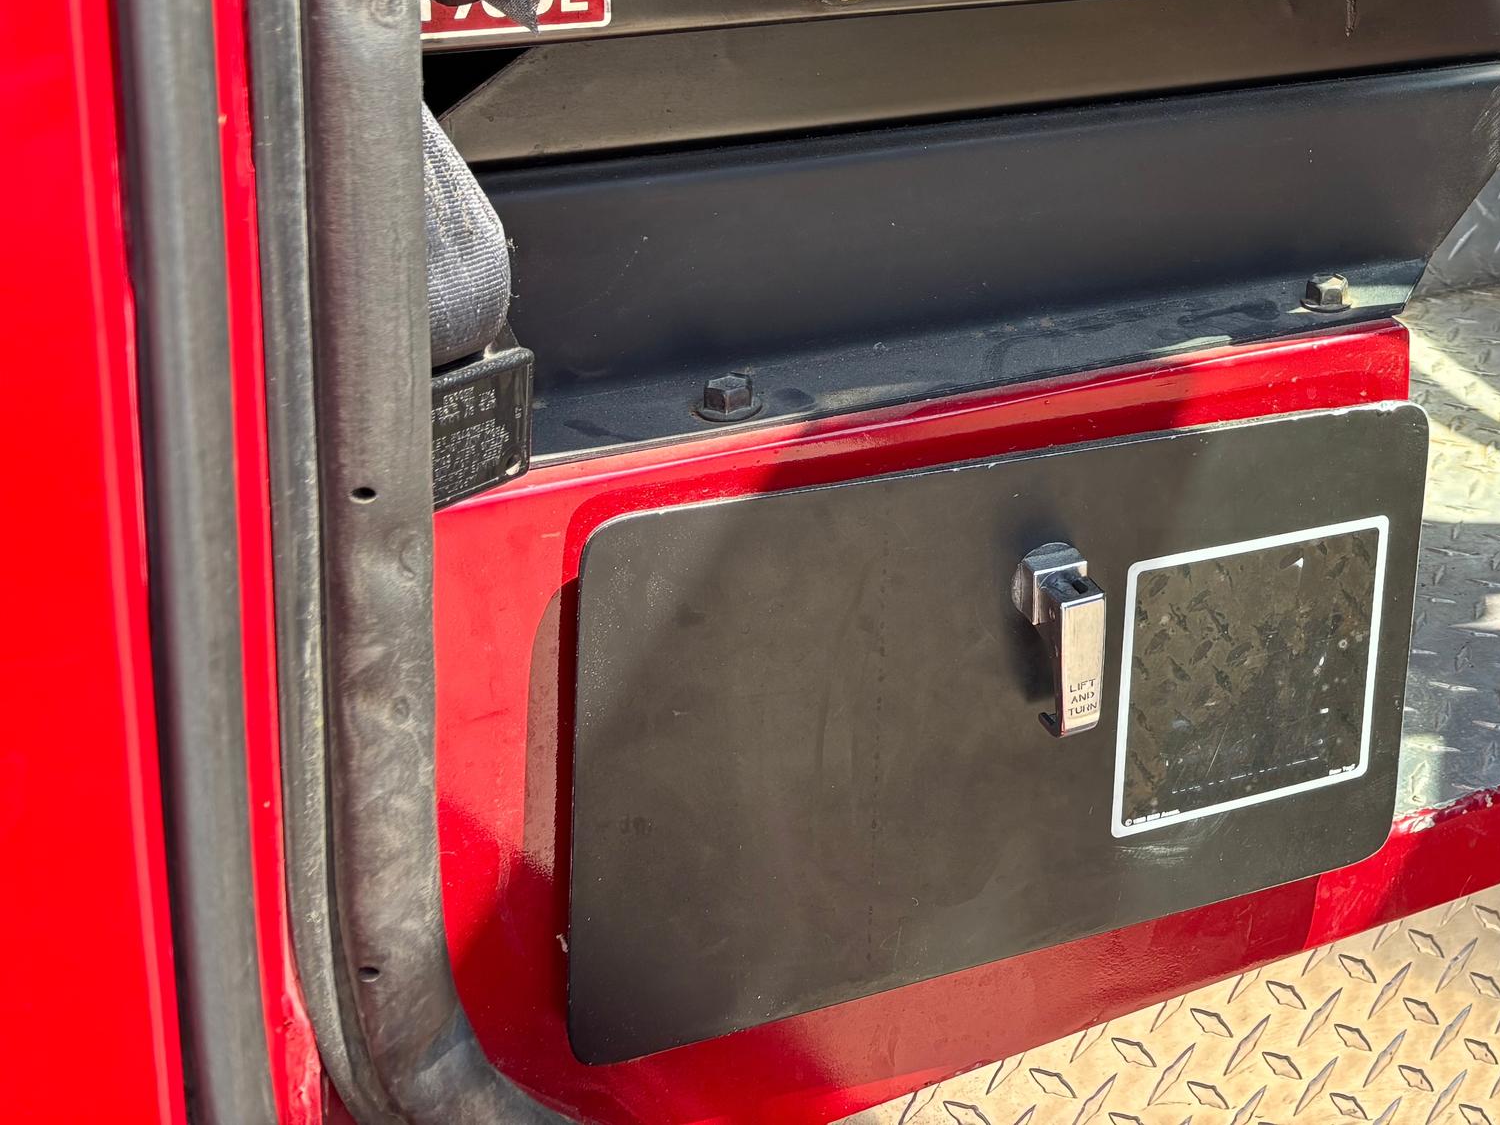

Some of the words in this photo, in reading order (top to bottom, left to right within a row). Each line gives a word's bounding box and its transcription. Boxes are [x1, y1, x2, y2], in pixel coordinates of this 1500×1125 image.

[1069, 678, 1096, 693] LIFT
[1071, 691, 1095, 704] AND
[1068, 702, 1097, 716] TURN
